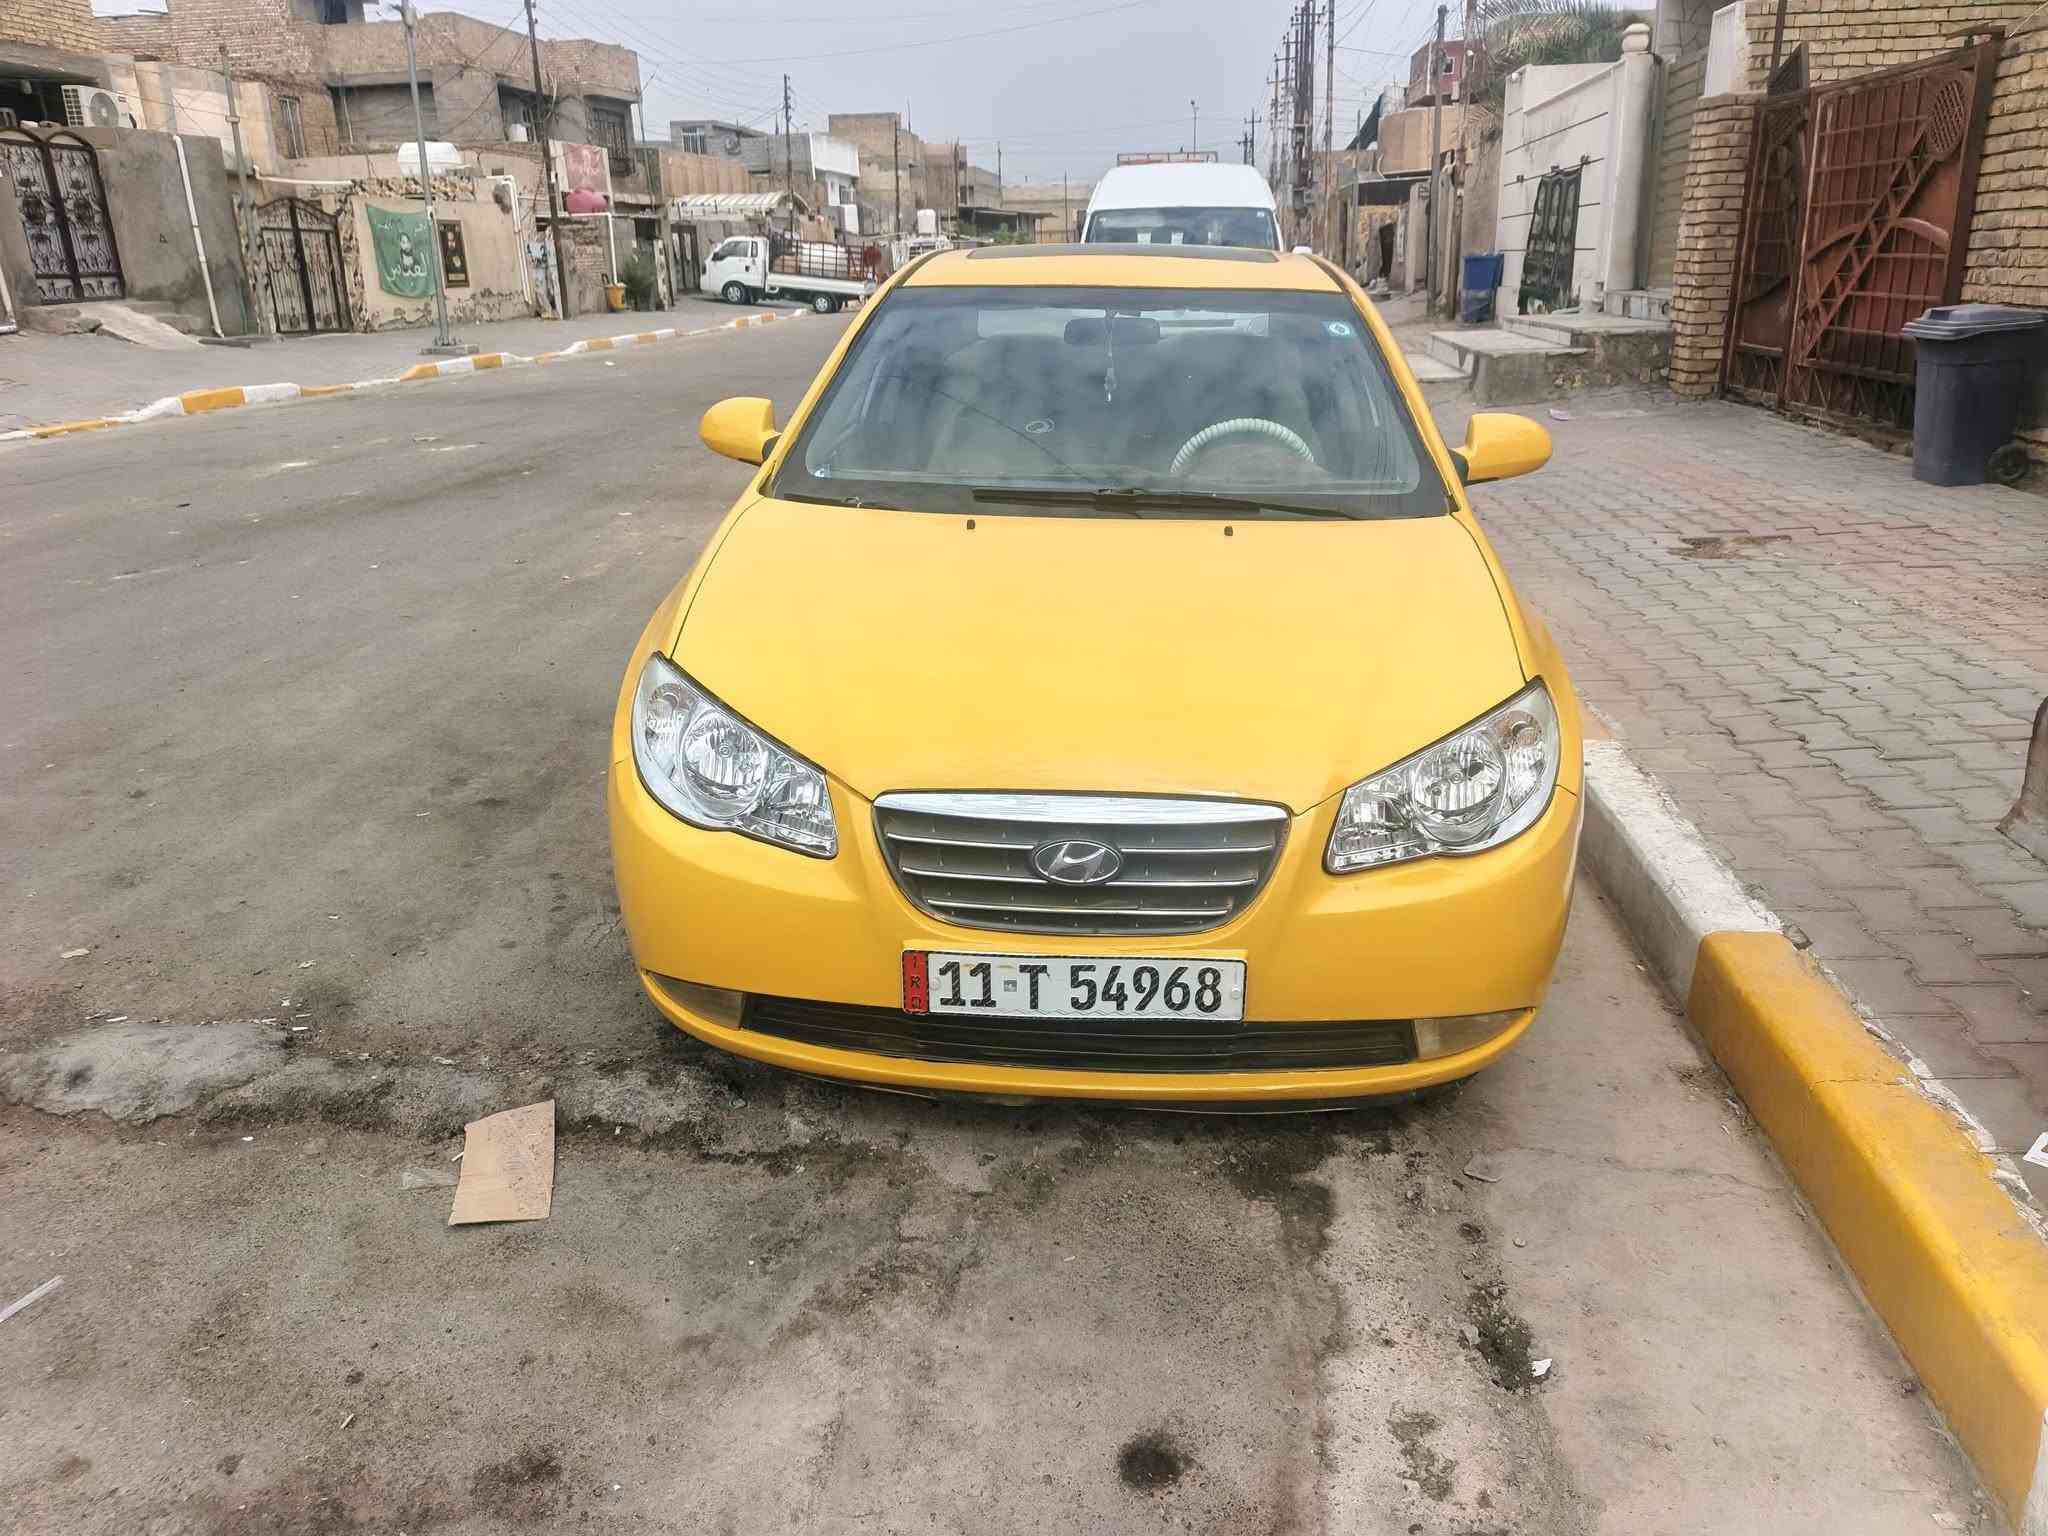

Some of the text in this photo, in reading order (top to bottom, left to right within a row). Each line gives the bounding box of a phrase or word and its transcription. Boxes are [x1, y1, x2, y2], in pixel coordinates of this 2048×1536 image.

[939, 961, 1222, 1013] 11 T 54968
